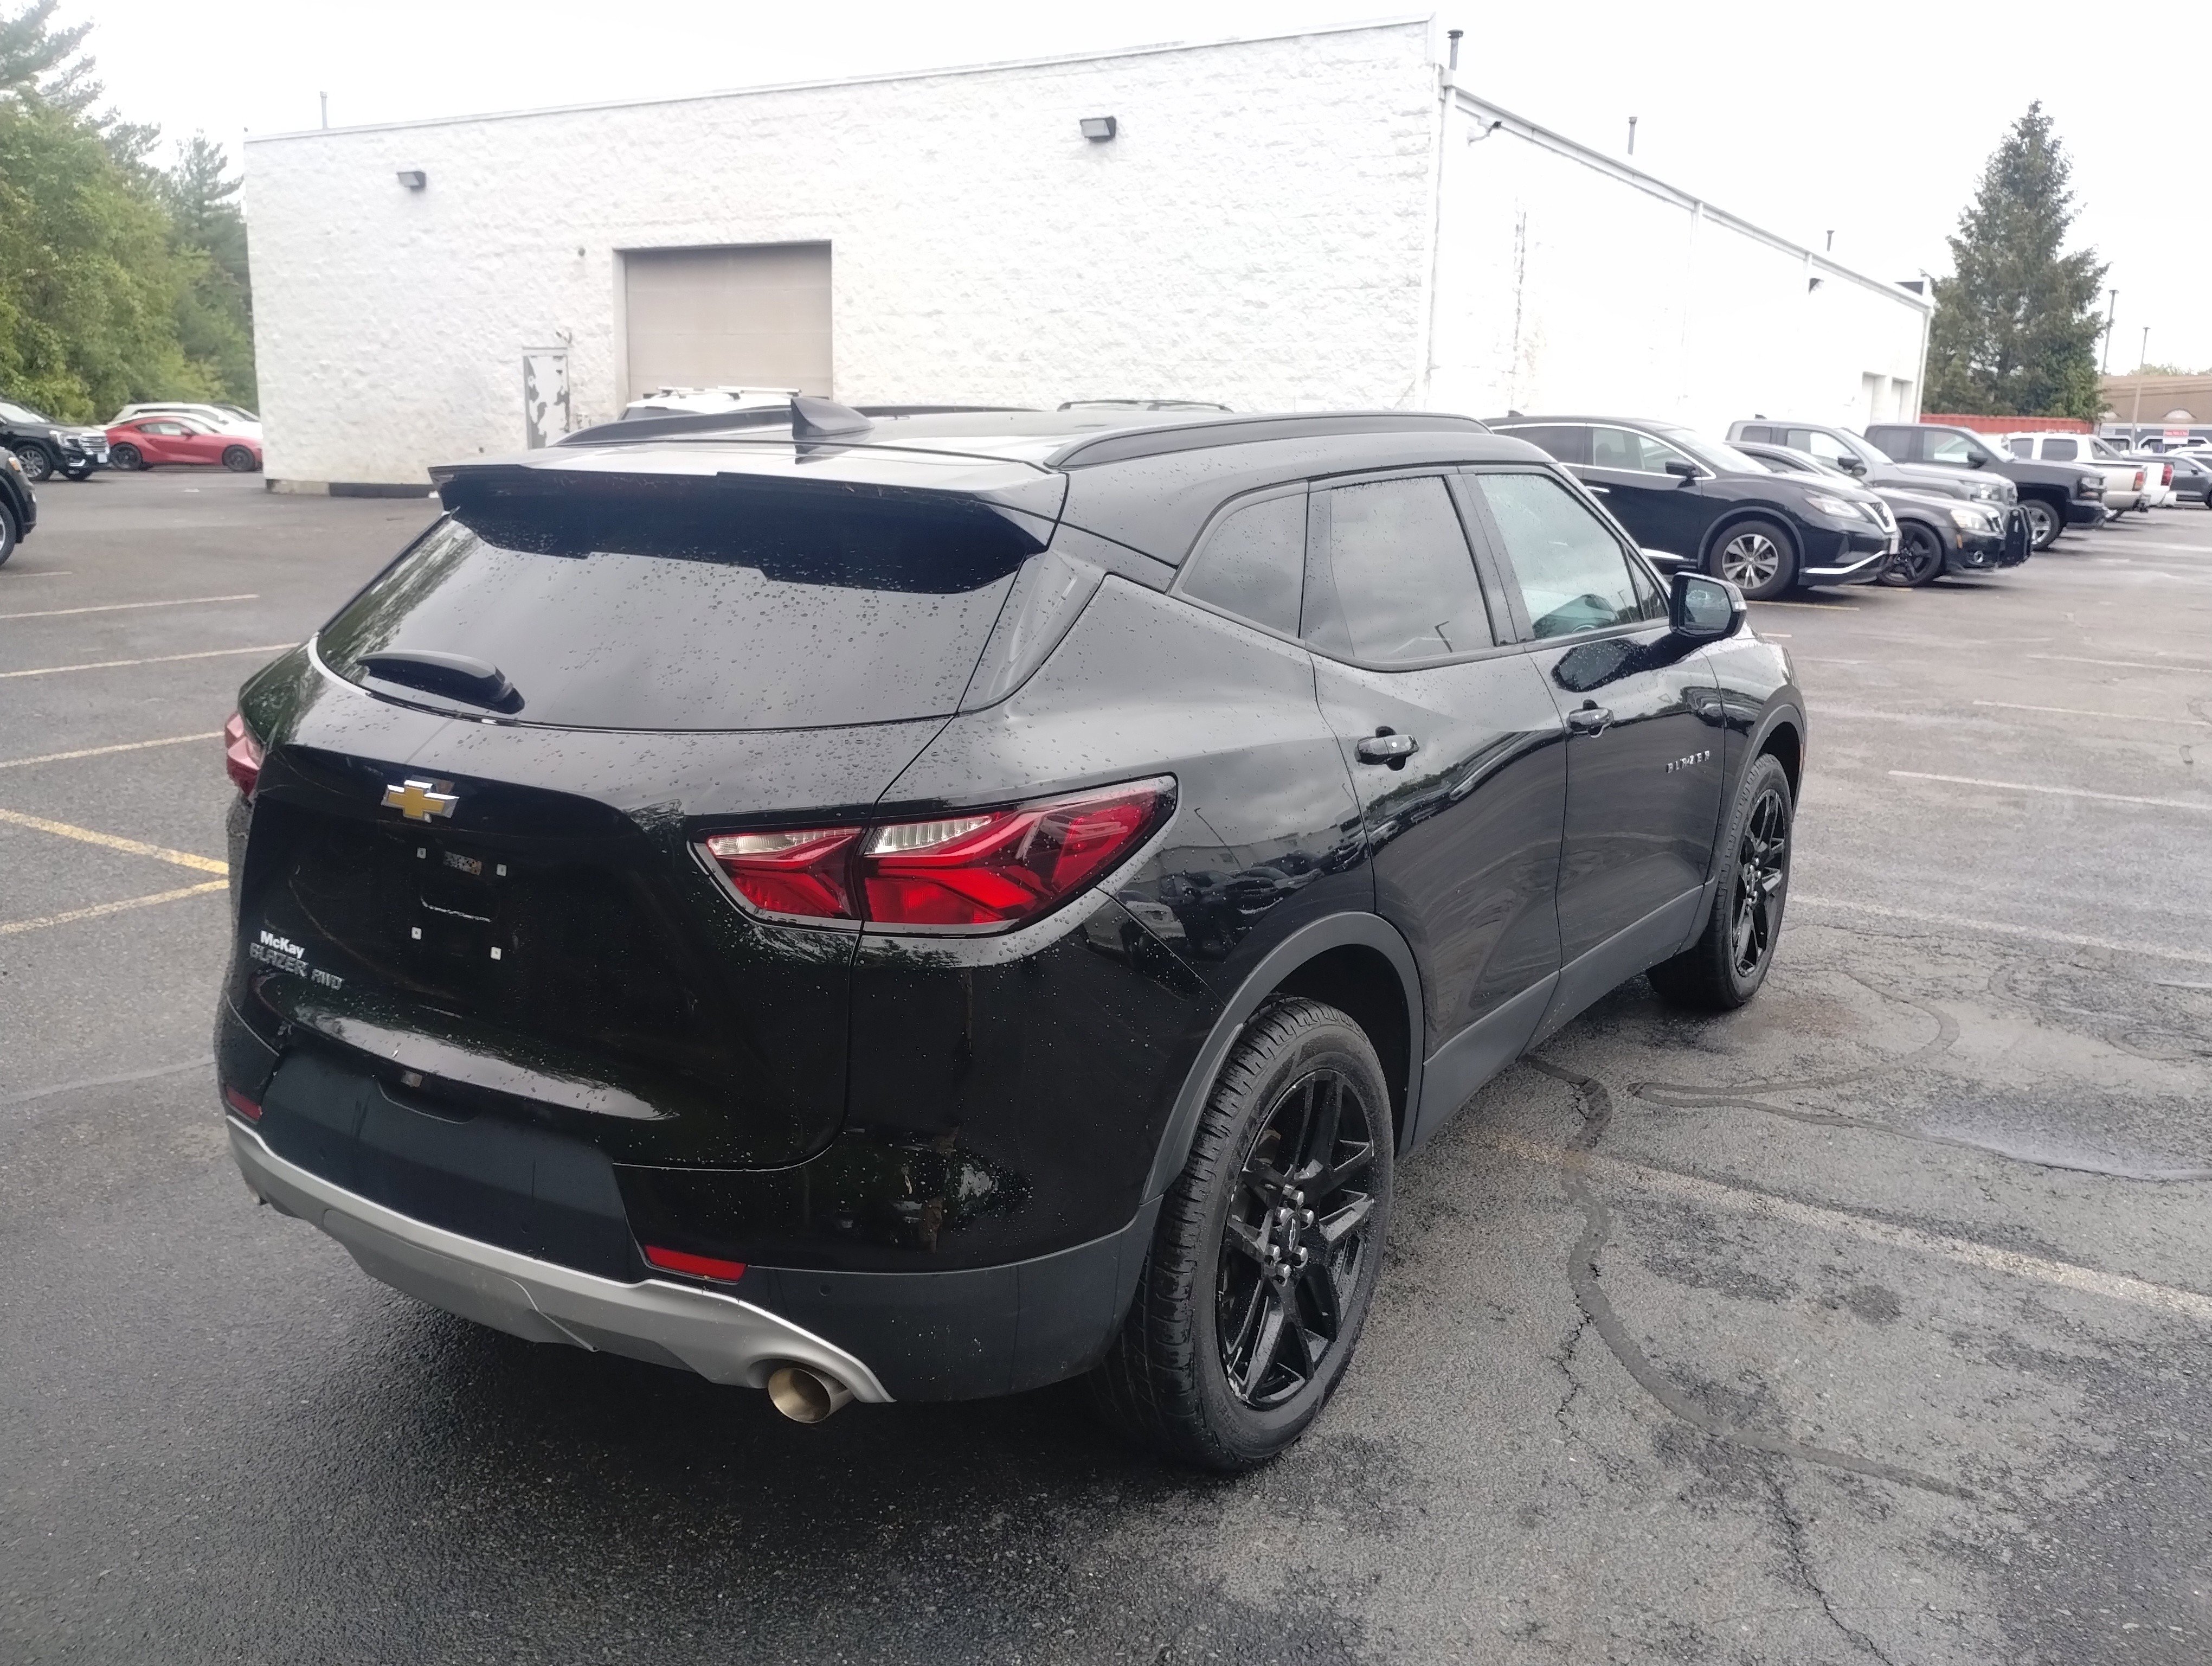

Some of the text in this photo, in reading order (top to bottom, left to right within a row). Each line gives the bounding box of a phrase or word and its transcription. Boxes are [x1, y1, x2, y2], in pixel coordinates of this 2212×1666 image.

[1667, 750, 1710, 773] BLAZER
[249, 942, 309, 978] BLAZER
[260, 930, 305, 960] McKay
